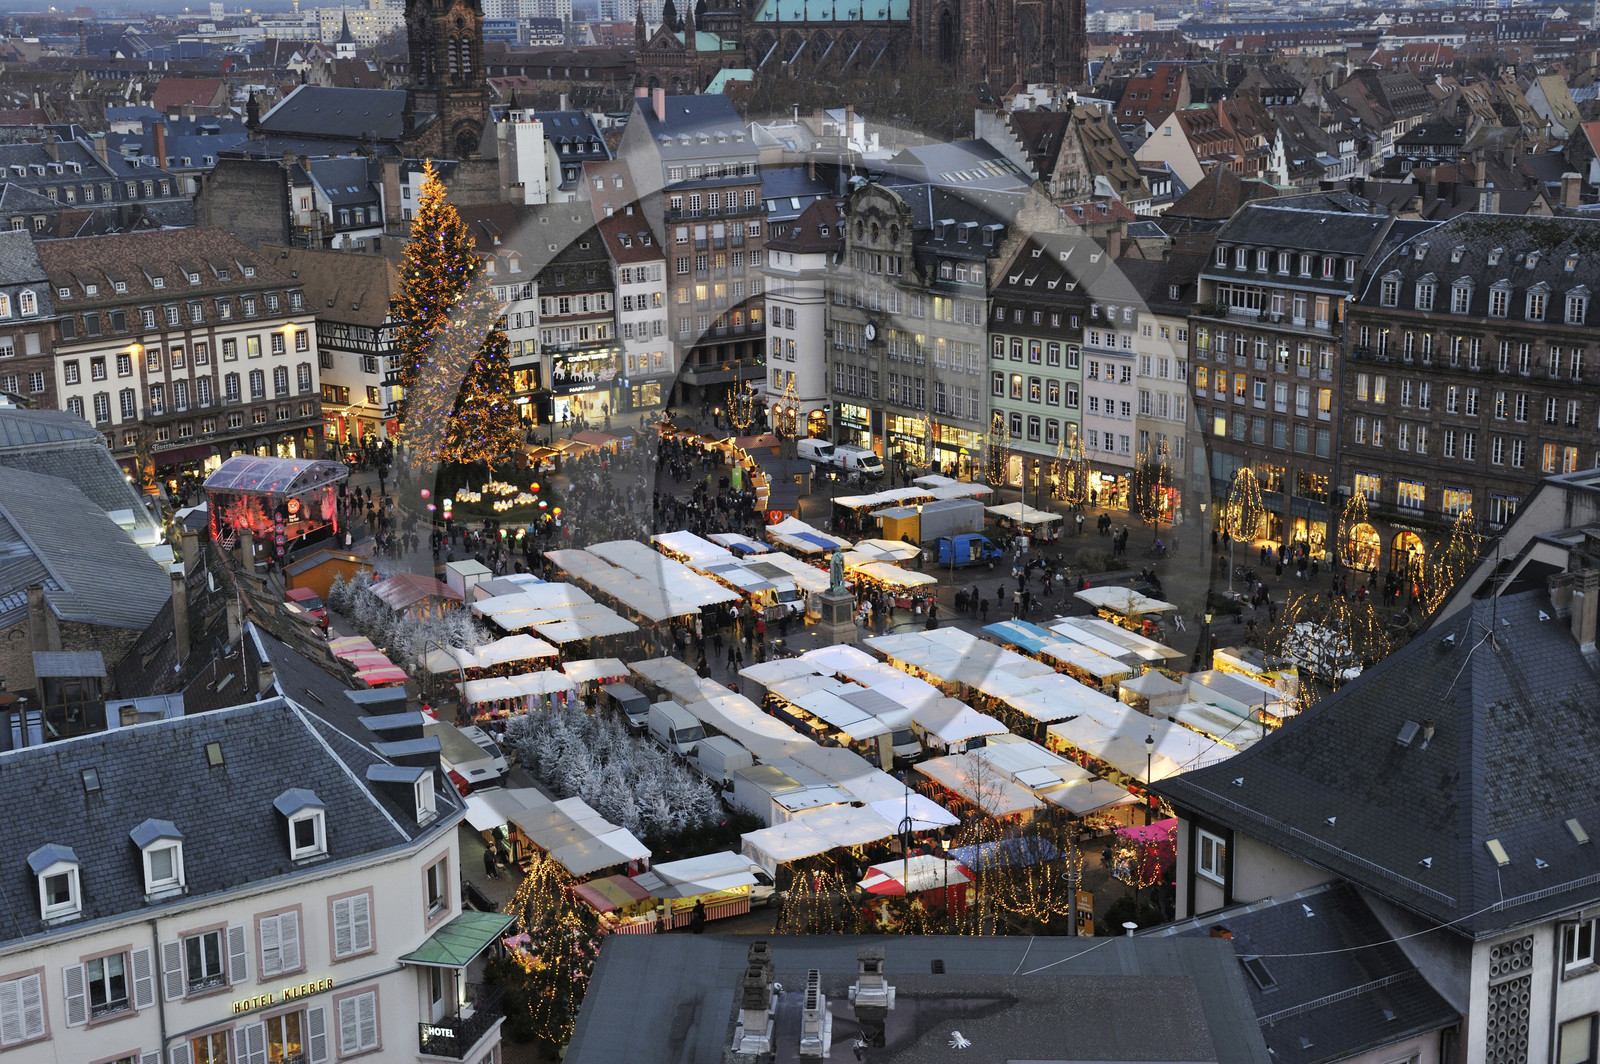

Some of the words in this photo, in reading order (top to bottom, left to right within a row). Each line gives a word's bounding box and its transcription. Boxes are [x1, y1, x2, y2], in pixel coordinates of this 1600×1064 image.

[233, 993, 275, 1014] HOTEL
[282, 978, 333, 1001] KLEBER
[428, 1026, 455, 1038] HOTEL
